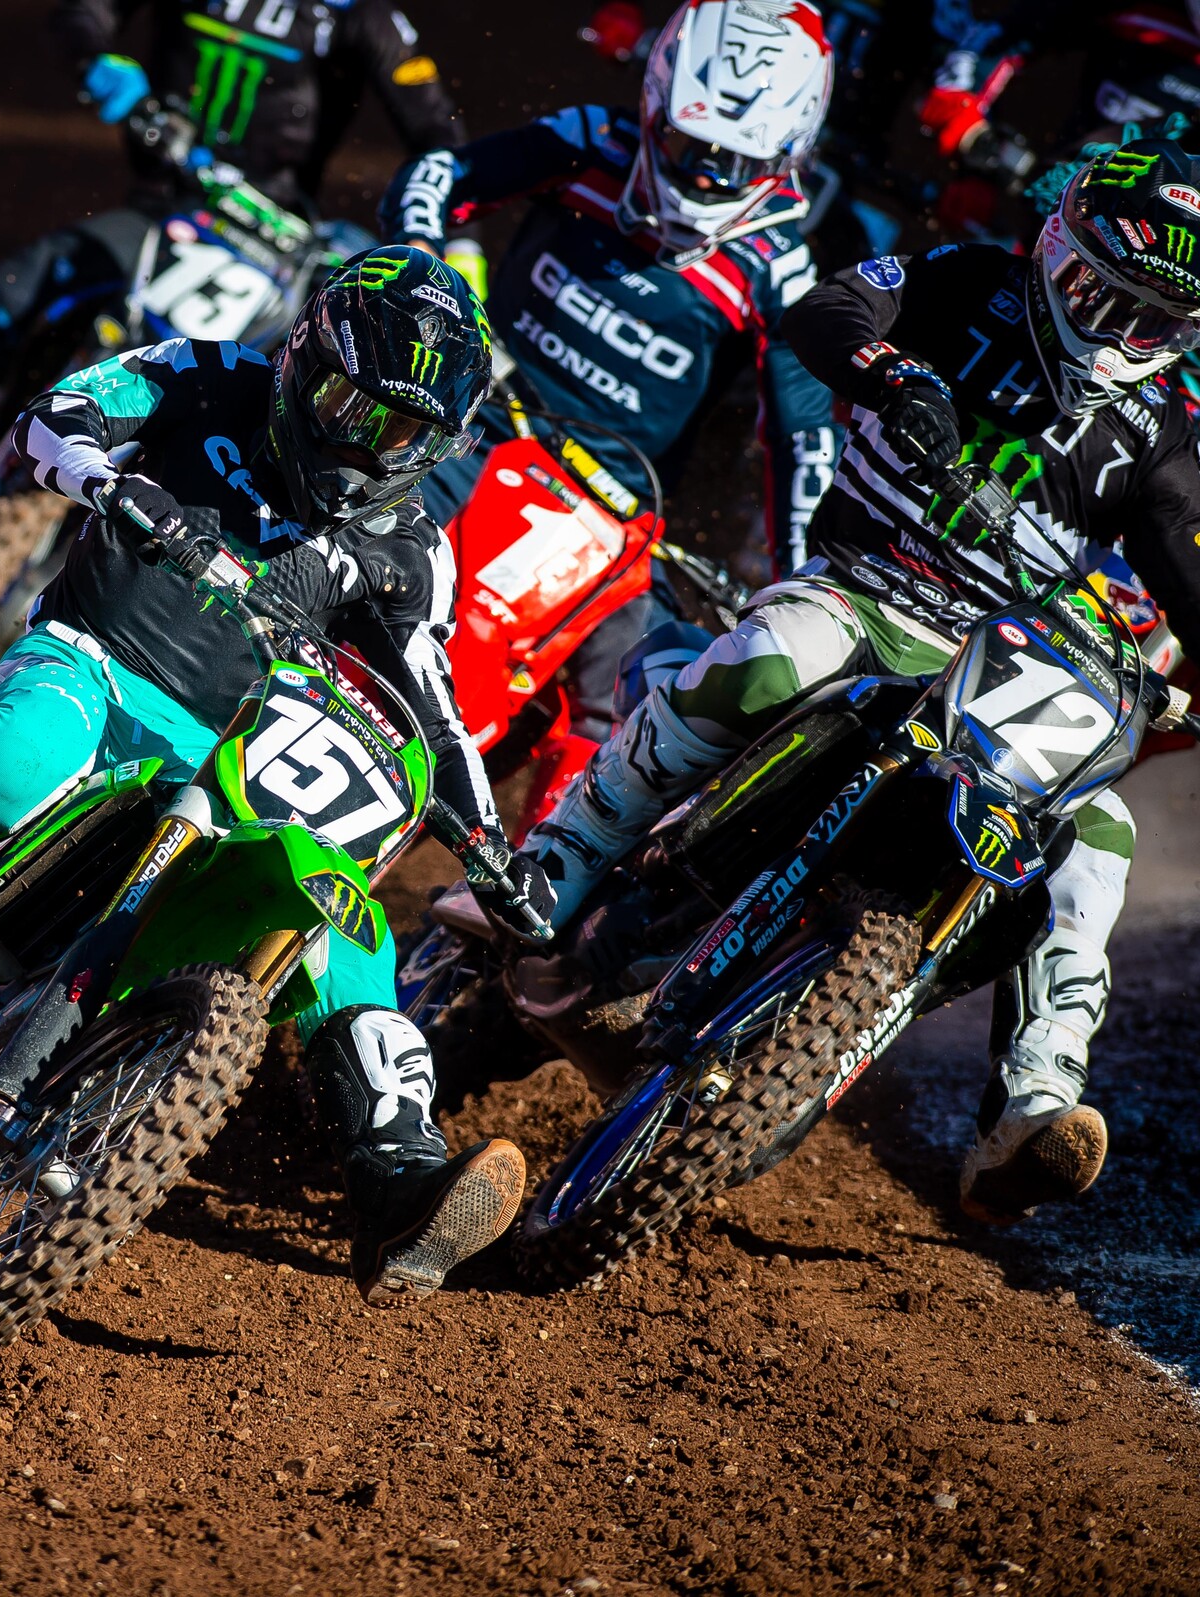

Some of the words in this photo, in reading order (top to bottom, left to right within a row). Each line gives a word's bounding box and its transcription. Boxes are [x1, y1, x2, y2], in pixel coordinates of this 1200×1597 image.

[130, 242, 275, 341] 13
[1132, 251, 1200, 290] MONSTE
[530, 252, 695, 381] GEICO
[513, 309, 643, 414] HONDA
[1094, 362, 1114, 378] BELL
[381, 379, 445, 417] MONSTER
[390, 390, 438, 415] ENERGY
[1063, 640, 1116, 697] MONSTER
[1067, 654, 1103, 690] ENERGY
[339, 708, 388, 765] MONSTER
[345, 722, 379, 760] ENERGY
[964, 651, 1116, 783] 12
[246, 693, 407, 846] 157
[154, 823, 188, 869] PRO
[982, 818, 1011, 851] YAMAHA
[709, 854, 809, 978] DUOP
[727, 870, 777, 916] YAMALUBE
[686, 917, 736, 974] BRAKING
[751, 914, 786, 957] CYCRA
[827, 1052, 873, 1111] BRAKING
